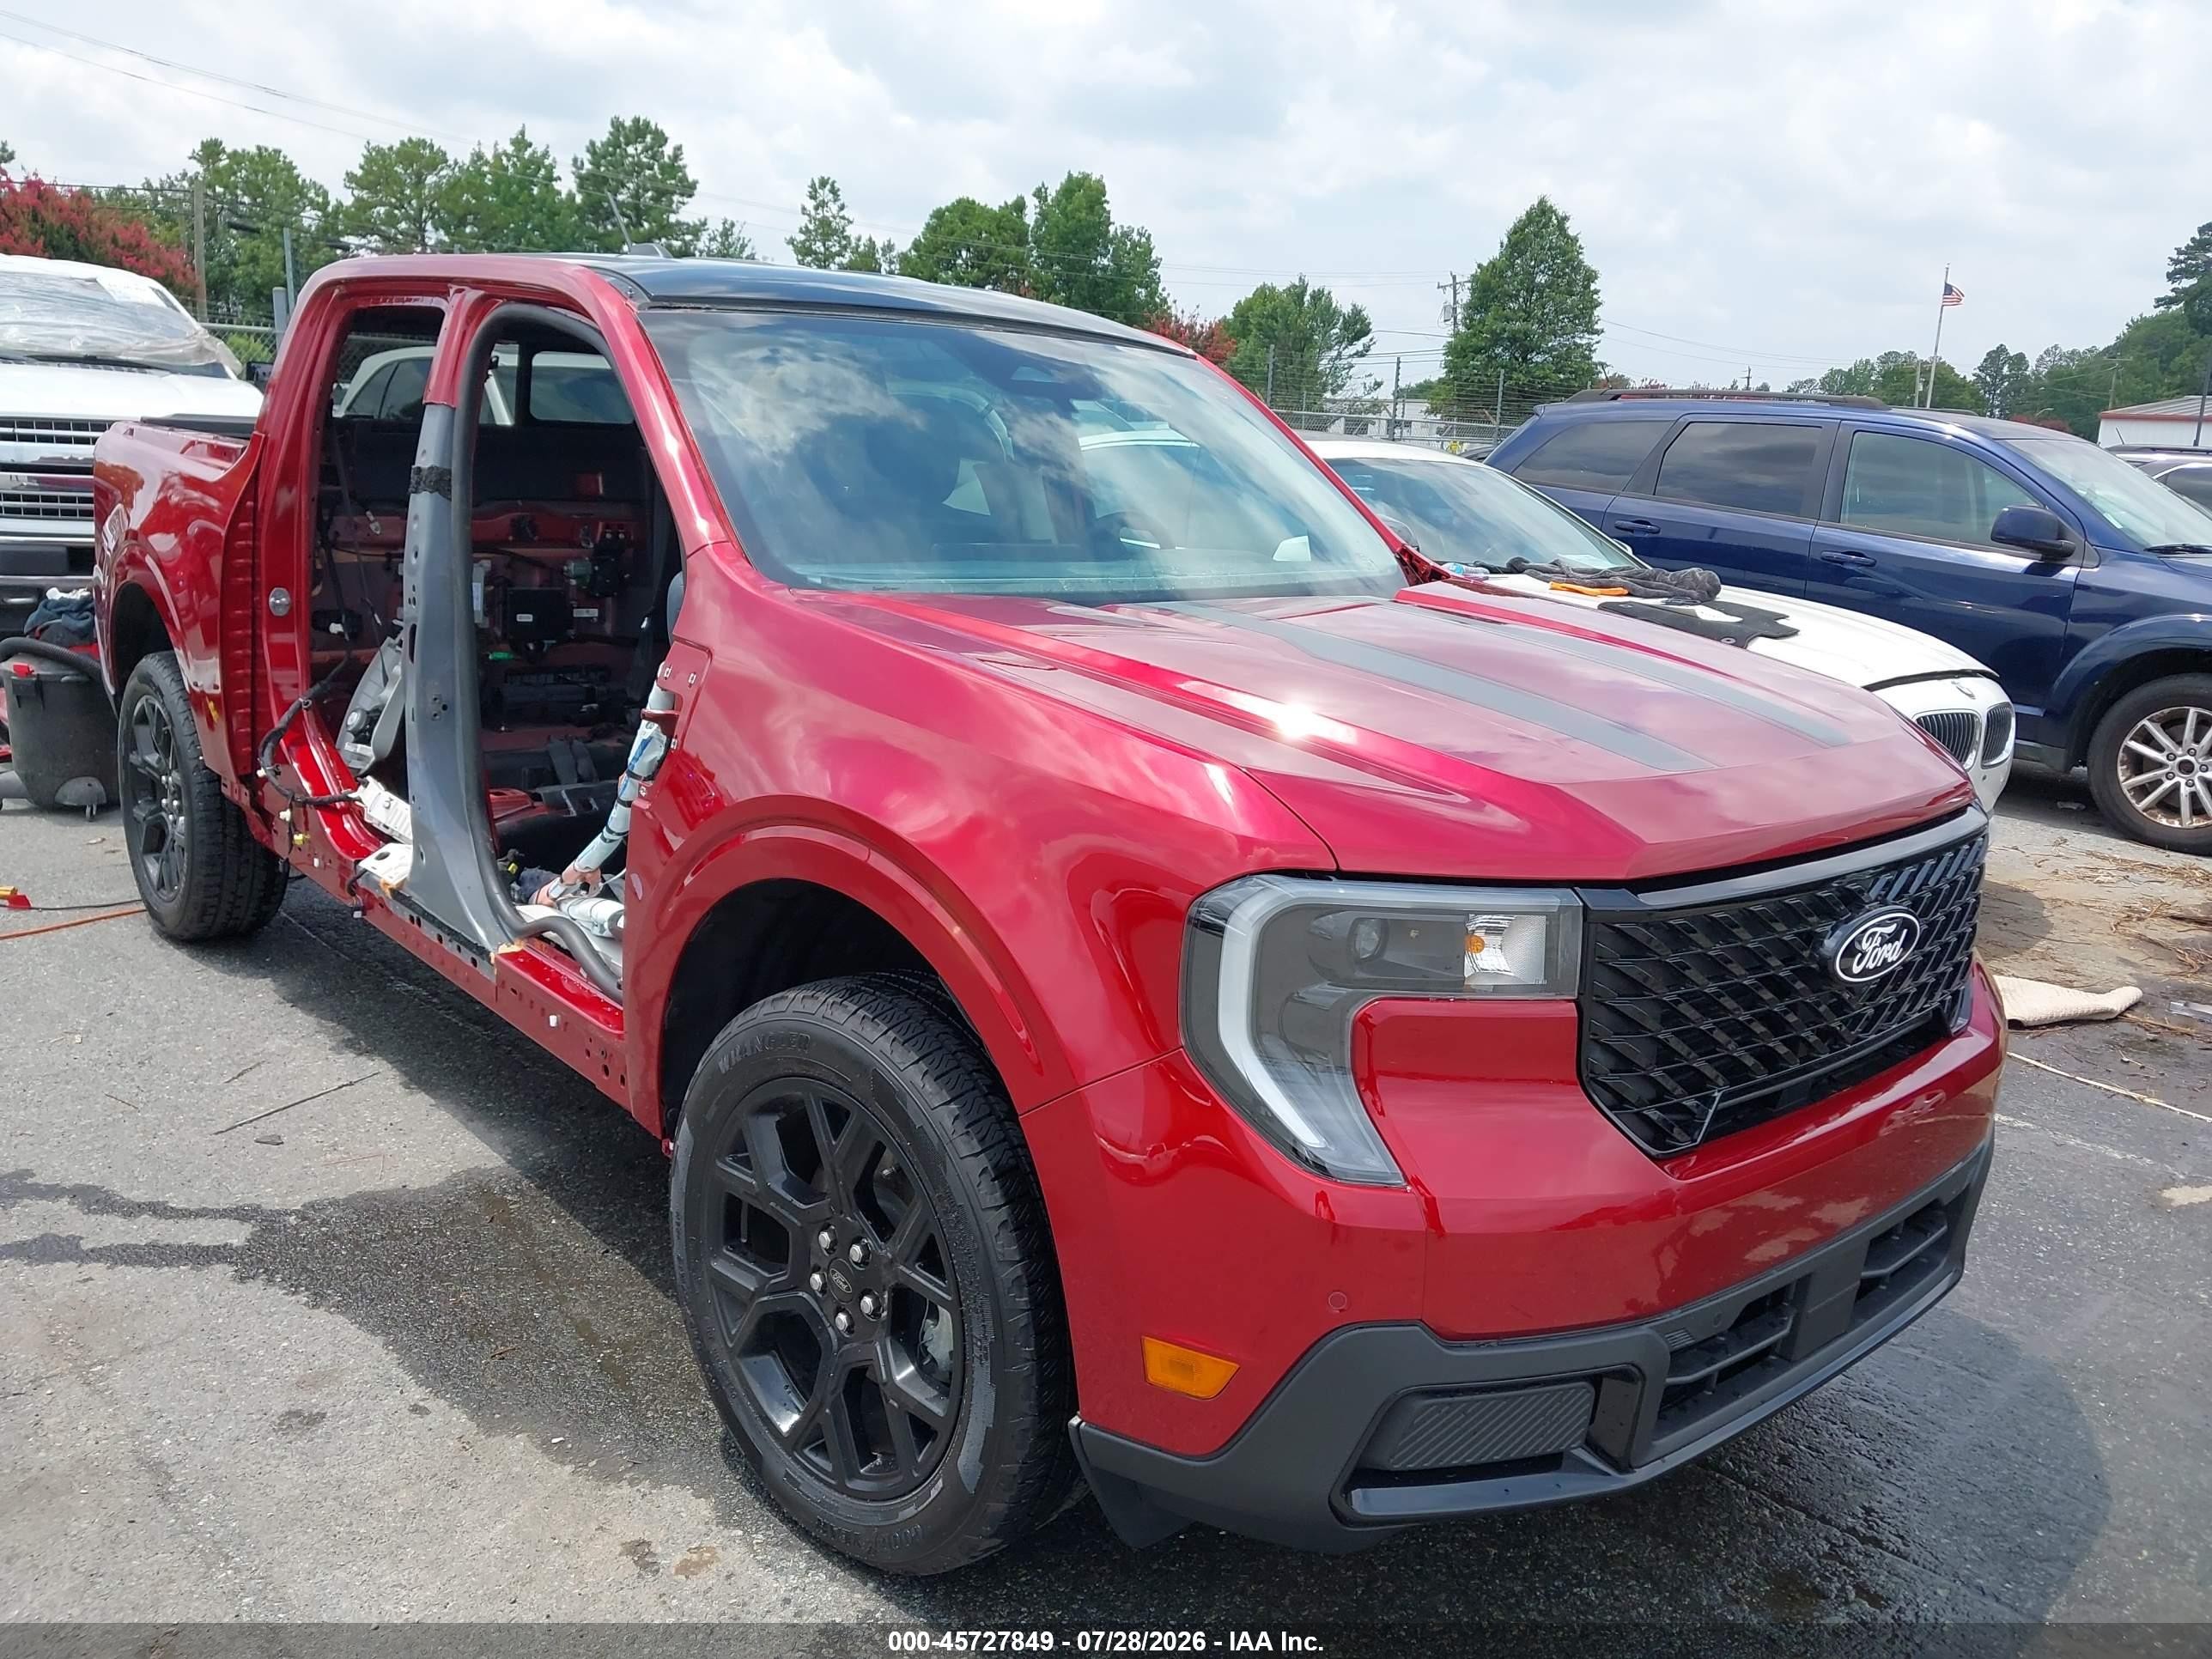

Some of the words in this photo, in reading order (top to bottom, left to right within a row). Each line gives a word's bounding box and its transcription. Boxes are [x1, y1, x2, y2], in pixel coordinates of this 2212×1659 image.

[1852, 922, 1908, 974] Ford
[718, 1031, 811, 1074] WRANGLER
[832, 1273, 848, 1291] Ford
